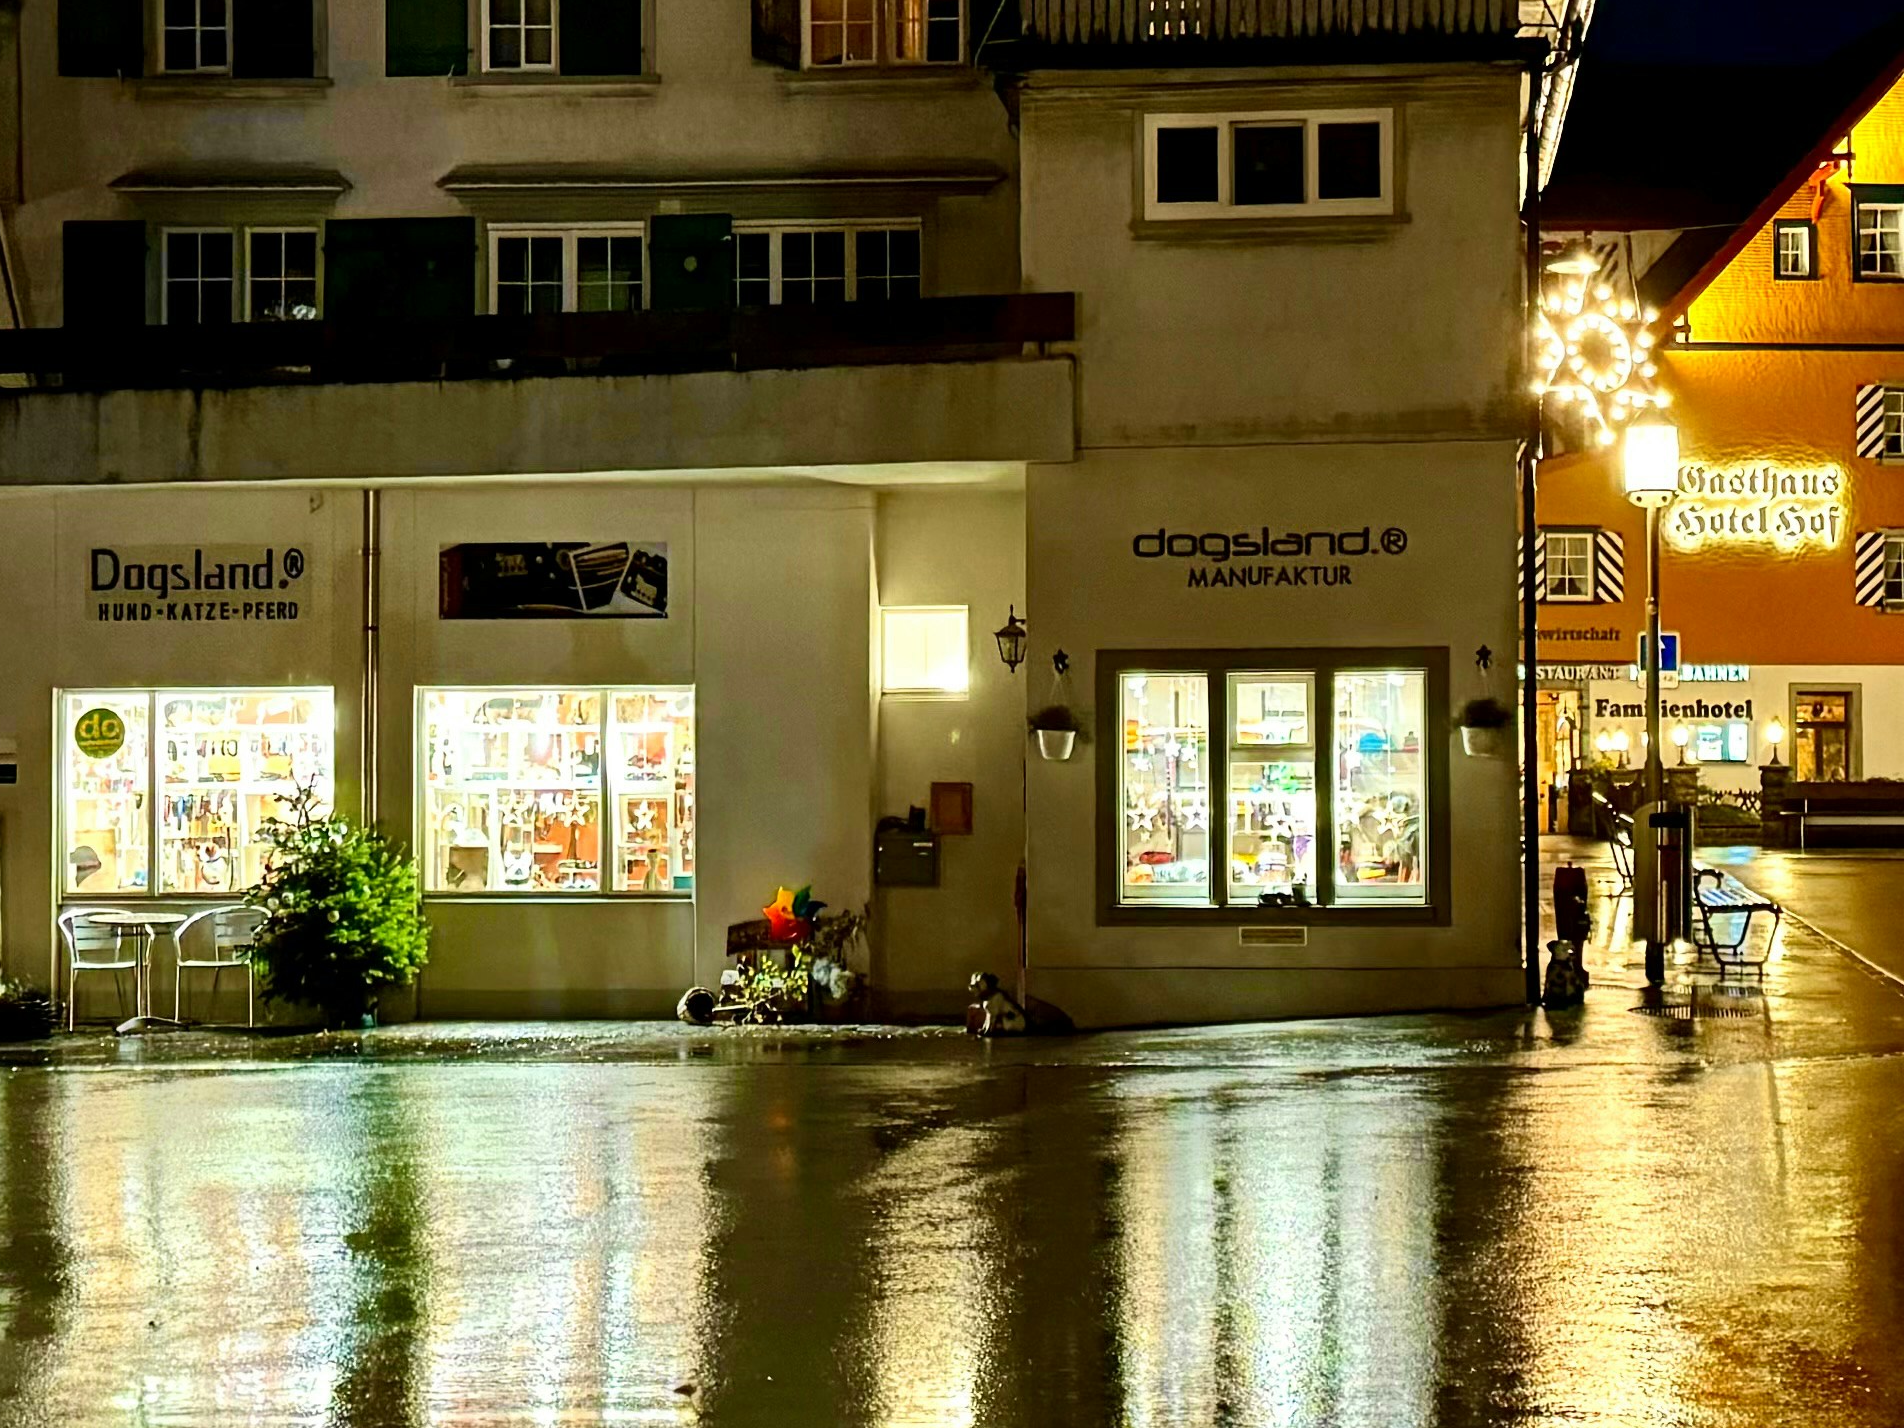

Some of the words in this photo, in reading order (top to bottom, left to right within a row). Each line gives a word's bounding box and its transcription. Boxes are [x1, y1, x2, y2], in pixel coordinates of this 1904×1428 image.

[1678, 466, 1839, 501] Gasthaus
[1675, 505, 1768, 539] Hotel
[1776, 505, 1840, 542] Hof
[1187, 565, 1352, 587] MANUFAKTUR
[1595, 699, 1753, 721] Famienhotel
